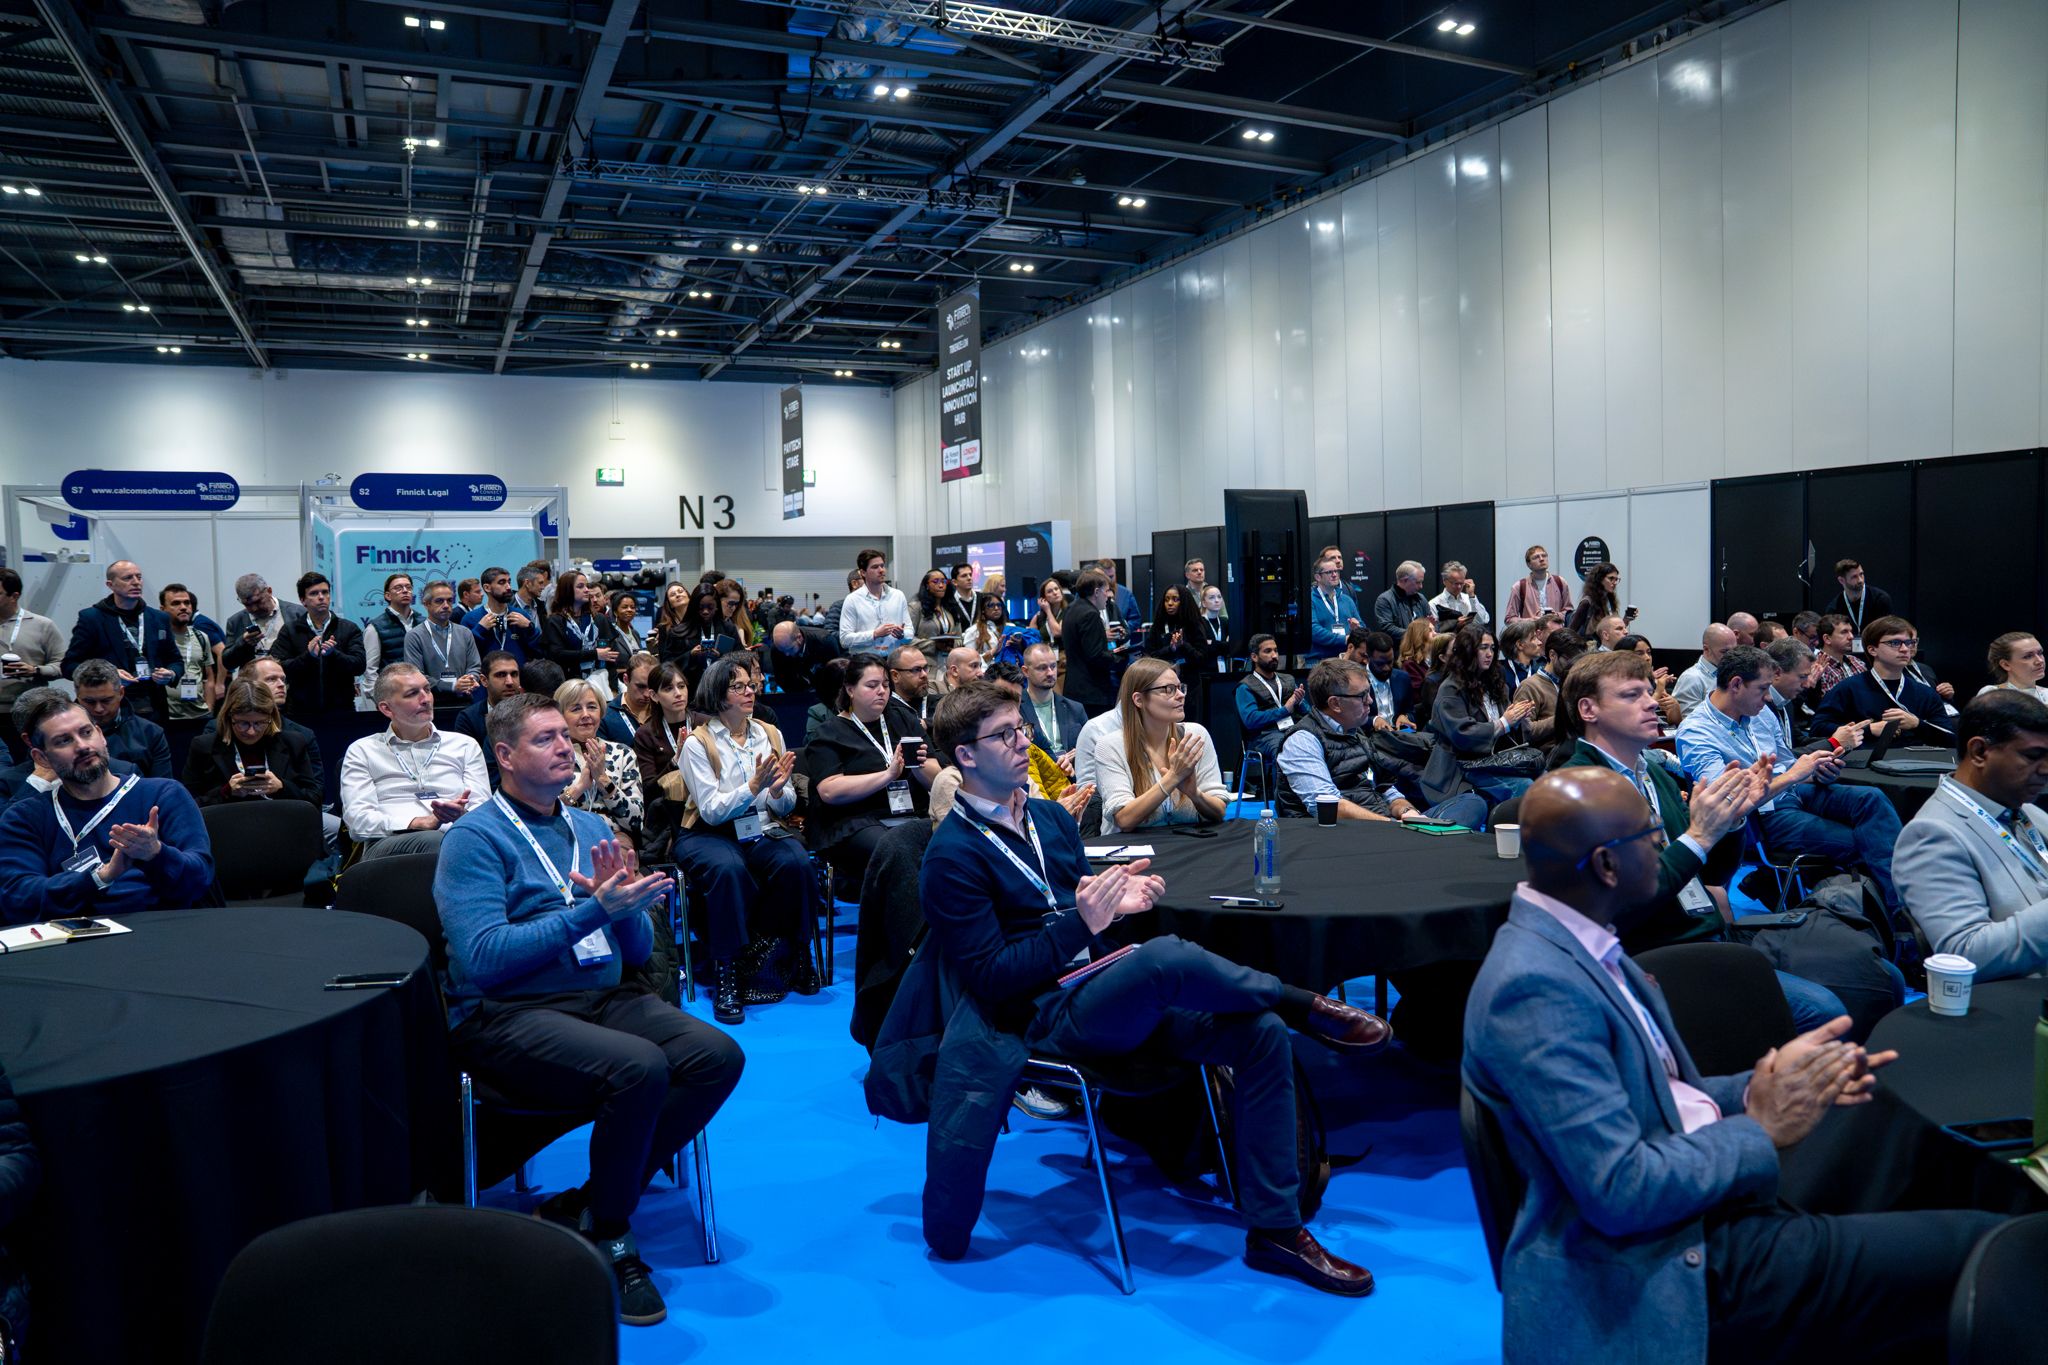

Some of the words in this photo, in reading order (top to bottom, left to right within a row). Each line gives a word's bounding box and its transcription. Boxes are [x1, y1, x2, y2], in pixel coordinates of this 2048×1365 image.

[946, 363, 963, 380] START
[964, 360, 972, 373] UP
[942, 375, 975, 399] LAUNCHPAD
[943, 391, 978, 414] INNOVATION
[954, 412, 966, 426] HUB
[786, 455, 799, 469] STAGE
[71, 486, 84, 494] S7
[91, 487, 196, 495] www.calcomsoftware.com
[359, 488, 370, 496] S2
[396, 488, 426, 496] Finnick
[427, 488, 449, 498] Legal
[679, 495, 736, 530] N3
[356, 545, 441, 564] Finnick
